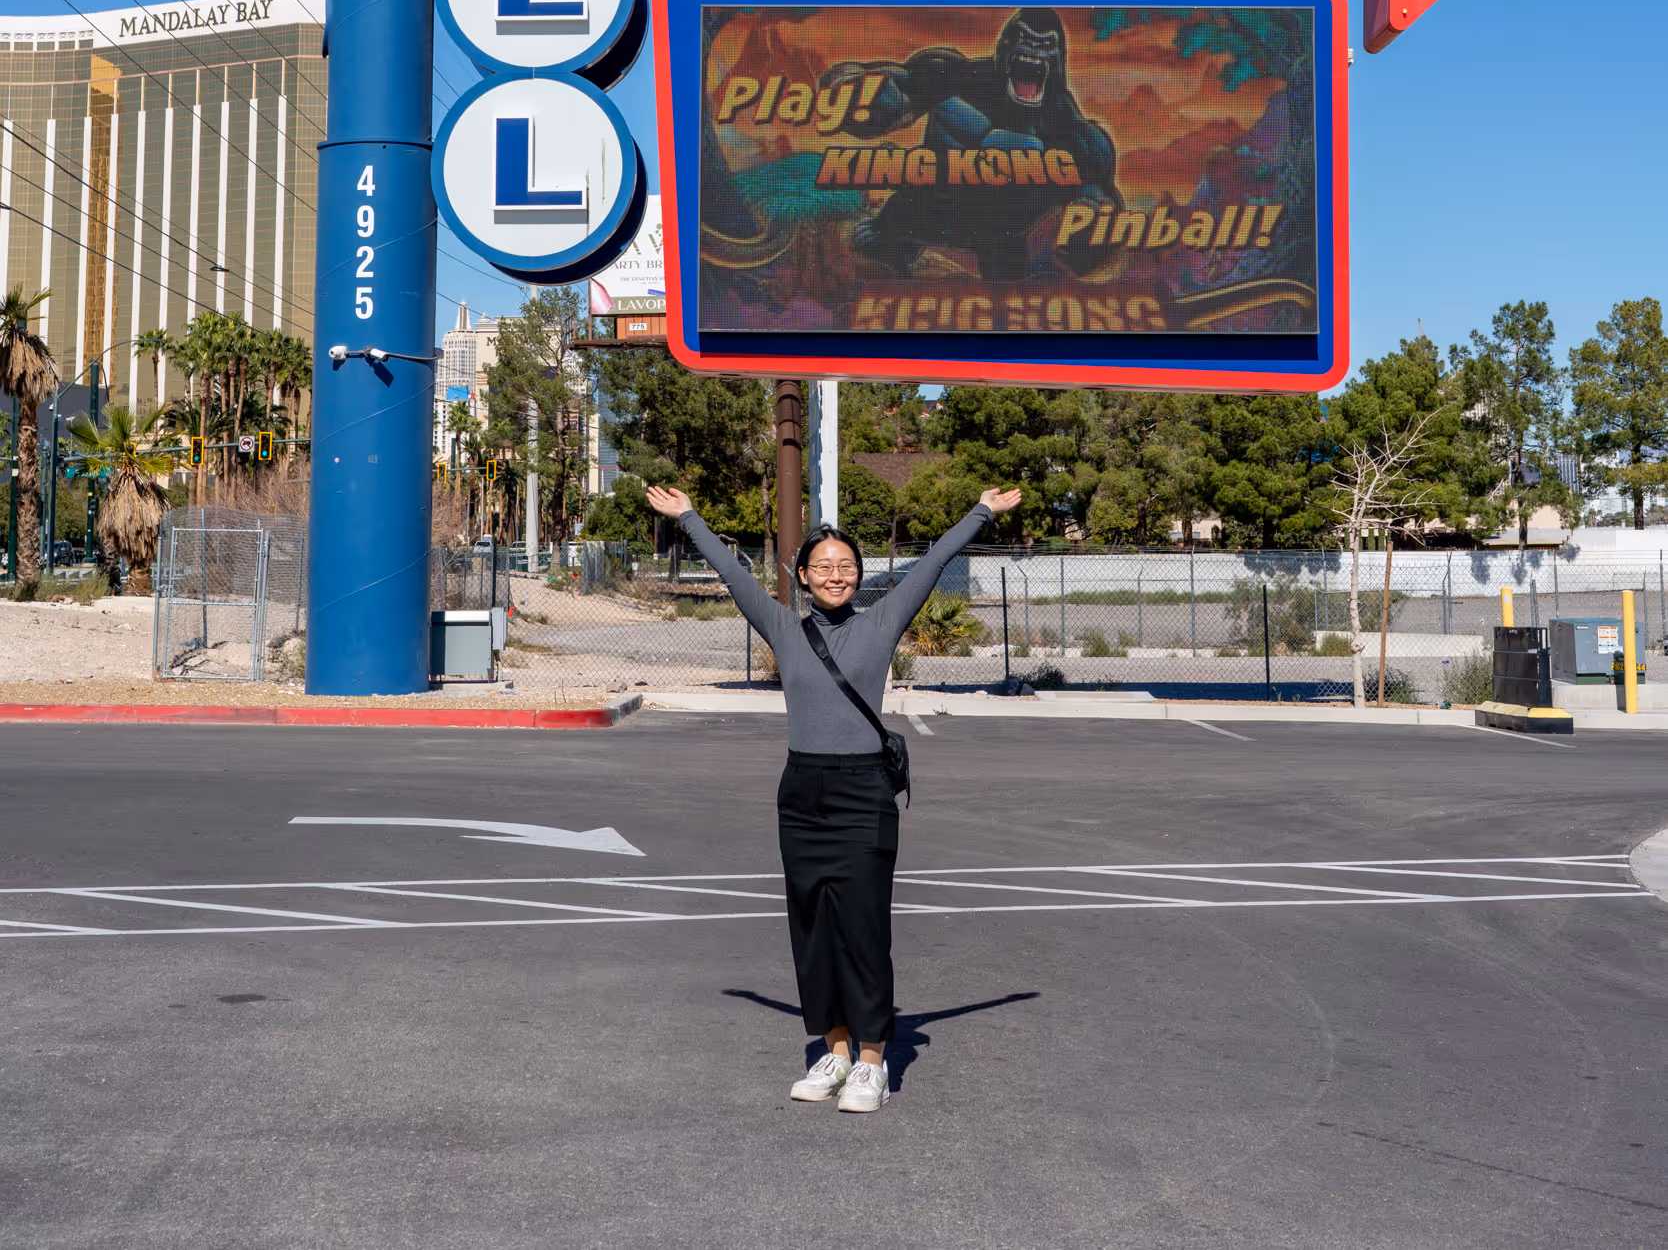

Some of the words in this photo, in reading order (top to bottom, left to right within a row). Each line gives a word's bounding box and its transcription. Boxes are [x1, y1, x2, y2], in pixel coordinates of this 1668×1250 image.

[119, 4, 231, 38] MANDALAY
[717, 74, 886, 132] Play!
[816, 147, 938, 187] KING
[946, 147, 1083, 187] KONG
[354, 165, 376, 320] 4925
[1057, 204, 1284, 250] Pinball!
[610, 259, 642, 270] ARTY
[618, 299, 666, 311] LAVOP
